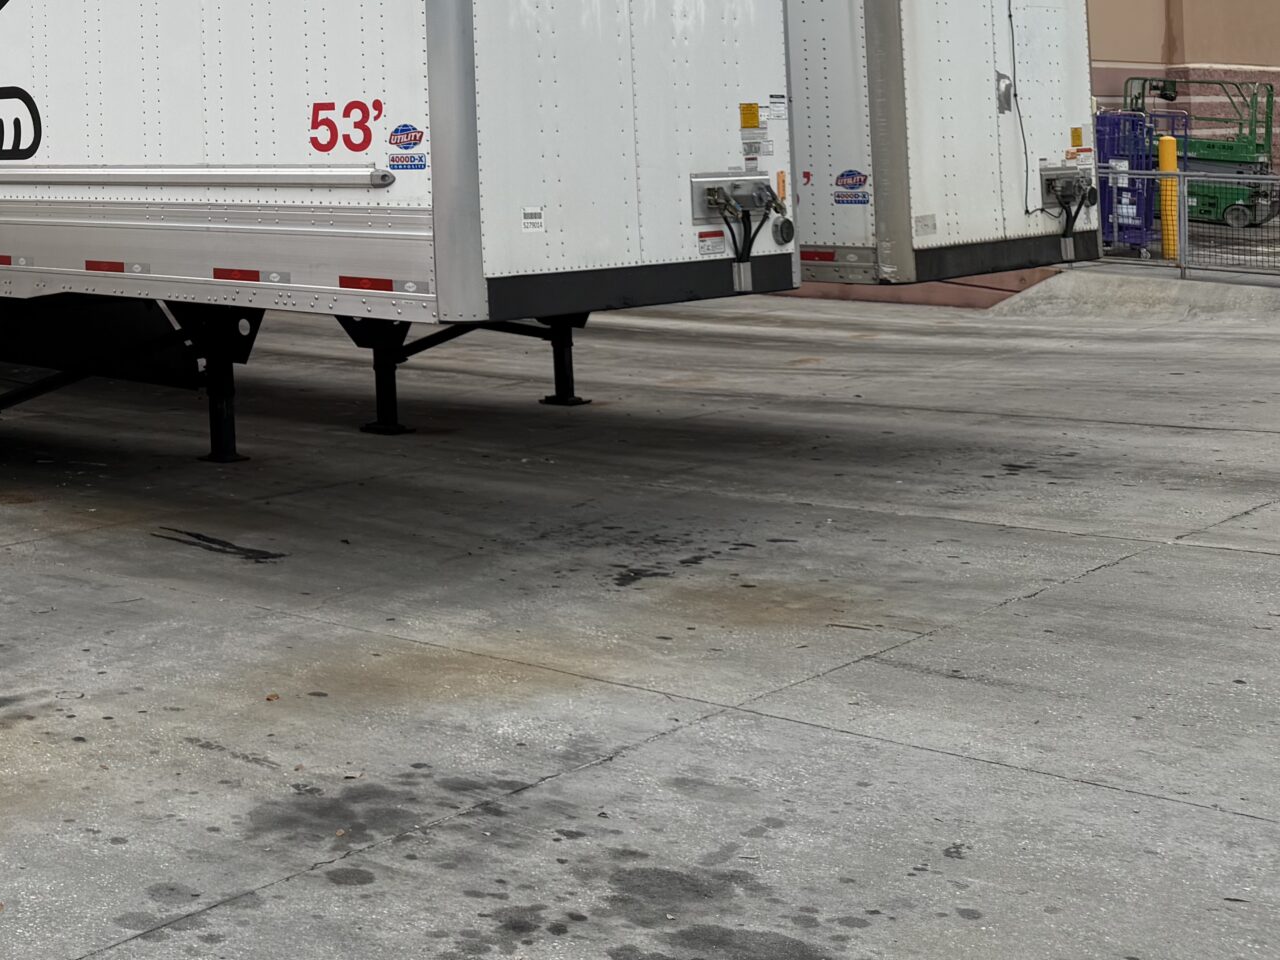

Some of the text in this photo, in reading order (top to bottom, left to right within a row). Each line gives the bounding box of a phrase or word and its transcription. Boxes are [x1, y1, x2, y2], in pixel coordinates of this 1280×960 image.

[390, 131, 423, 144] UTILITY
[390, 155, 424, 163] 4000D-X
[836, 176, 866, 185] UTILITY
